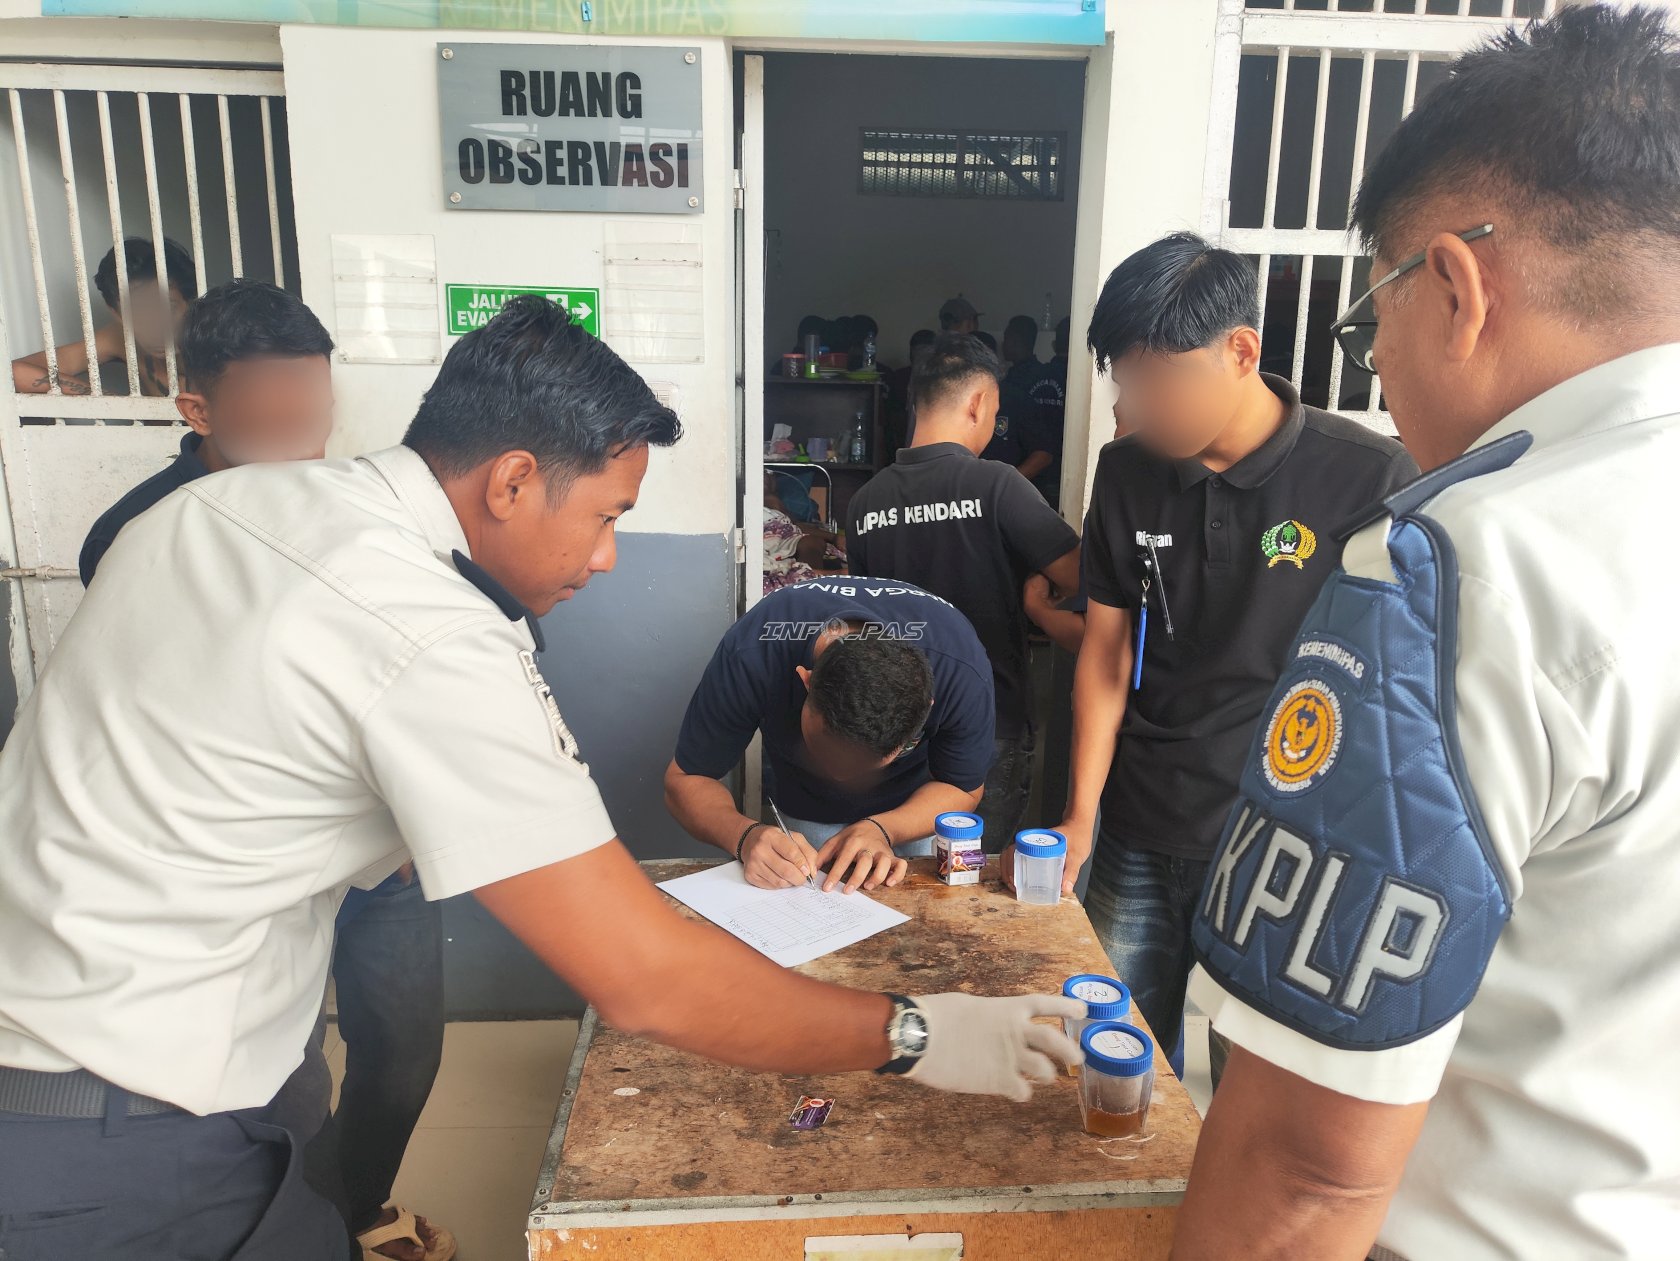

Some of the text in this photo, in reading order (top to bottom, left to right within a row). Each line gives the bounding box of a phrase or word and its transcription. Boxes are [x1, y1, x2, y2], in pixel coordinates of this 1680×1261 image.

[500, 70, 642, 119] RUANG
[458, 138, 689, 188] OBSERVASI
[468, 293, 519, 309] JAL
[904, 498, 982, 524] KENDARI
[1203, 805, 1446, 1012] KPLP
